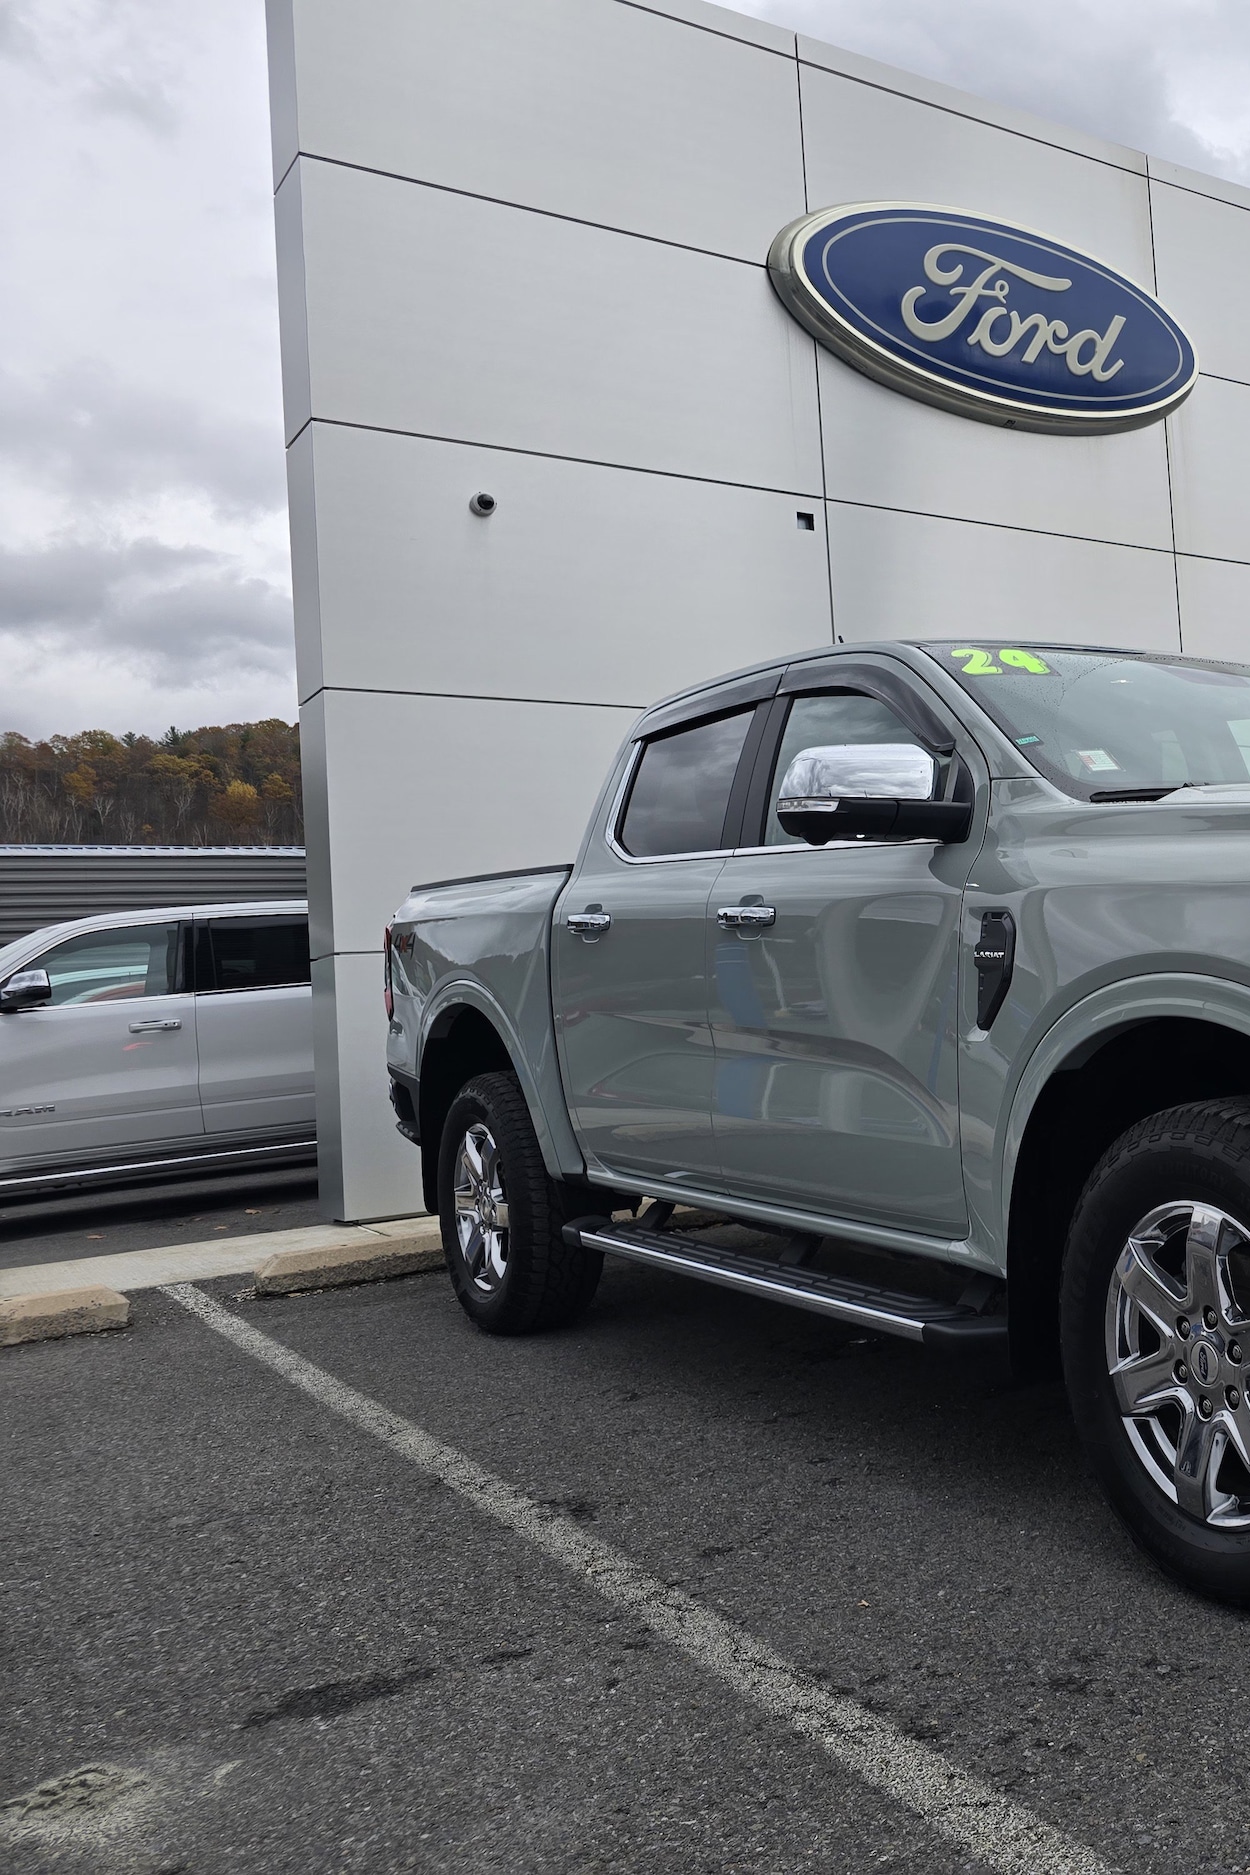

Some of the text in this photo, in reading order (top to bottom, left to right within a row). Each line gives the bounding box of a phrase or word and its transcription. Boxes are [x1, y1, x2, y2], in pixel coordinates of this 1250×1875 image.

[901, 243, 1127, 382] Ford
[951, 649, 1050, 675] 24
[974, 951, 1004, 959] LARIAT
